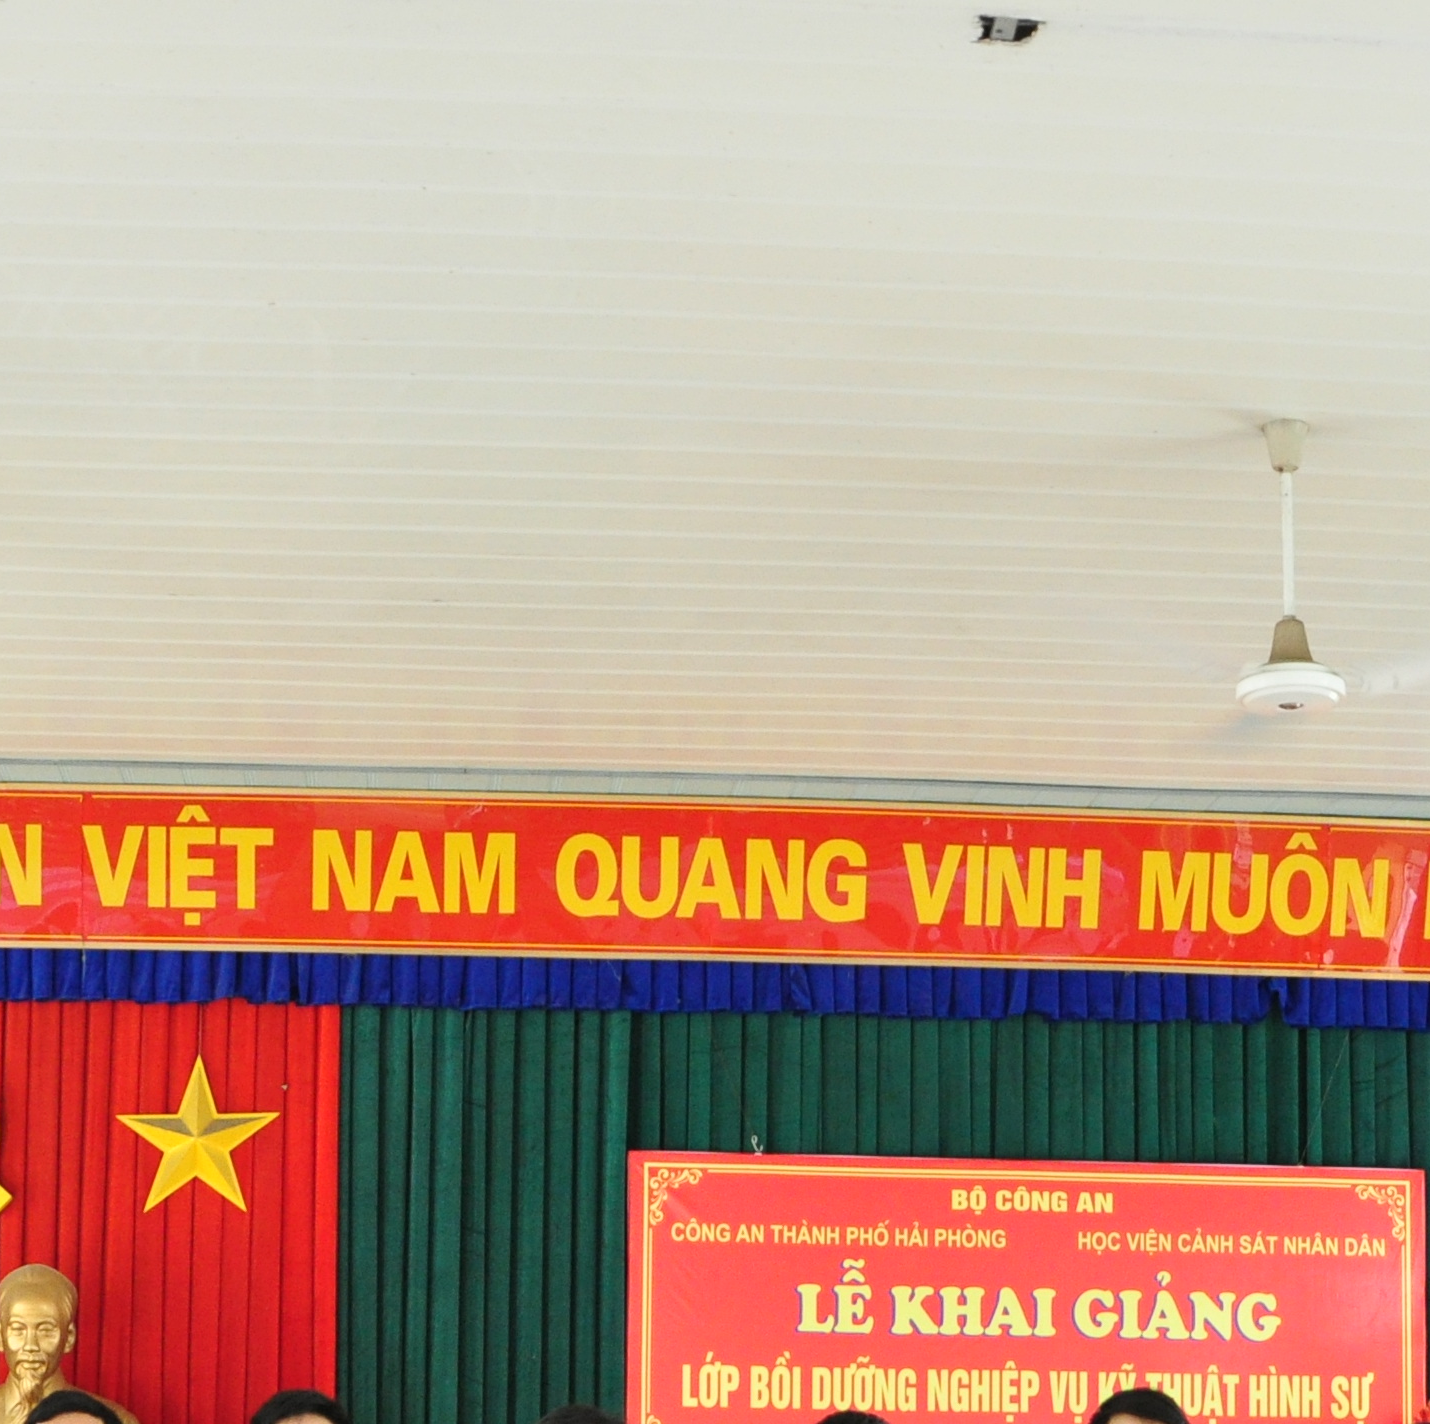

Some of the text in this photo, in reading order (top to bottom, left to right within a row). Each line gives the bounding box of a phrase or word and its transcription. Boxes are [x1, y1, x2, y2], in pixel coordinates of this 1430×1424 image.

[83, 805, 273, 925] VIỆT
[313, 830, 515, 913] NAM
[556, 834, 866, 922] QUANG
[904, 844, 1101, 928] VINH
[1139, 833, 1389, 938] MUÔN
[952, 1185, 1113, 1215] BỘ CÔNG AN
[671, 1218, 1006, 1248] CÔNG AN THÀNH PHỐ HẢI PHÒNG
[1078, 1228, 1386, 1257] HỌC VIỆN CẢNH SÁT NHÂN DÂN
[797, 1259, 1282, 1342] LỄ KHAI GIẢNG
[682, 1351, 740, 1408] LỚP
[750, 1351, 801, 1410] BỒI
[812, 1356, 917, 1412] DƯỠNG
[927, 1360, 1040, 1423] NGHIỆP
[1049, 1371, 1088, 1424] VỤ
[1249, 1366, 1321, 1418] HÌNH
